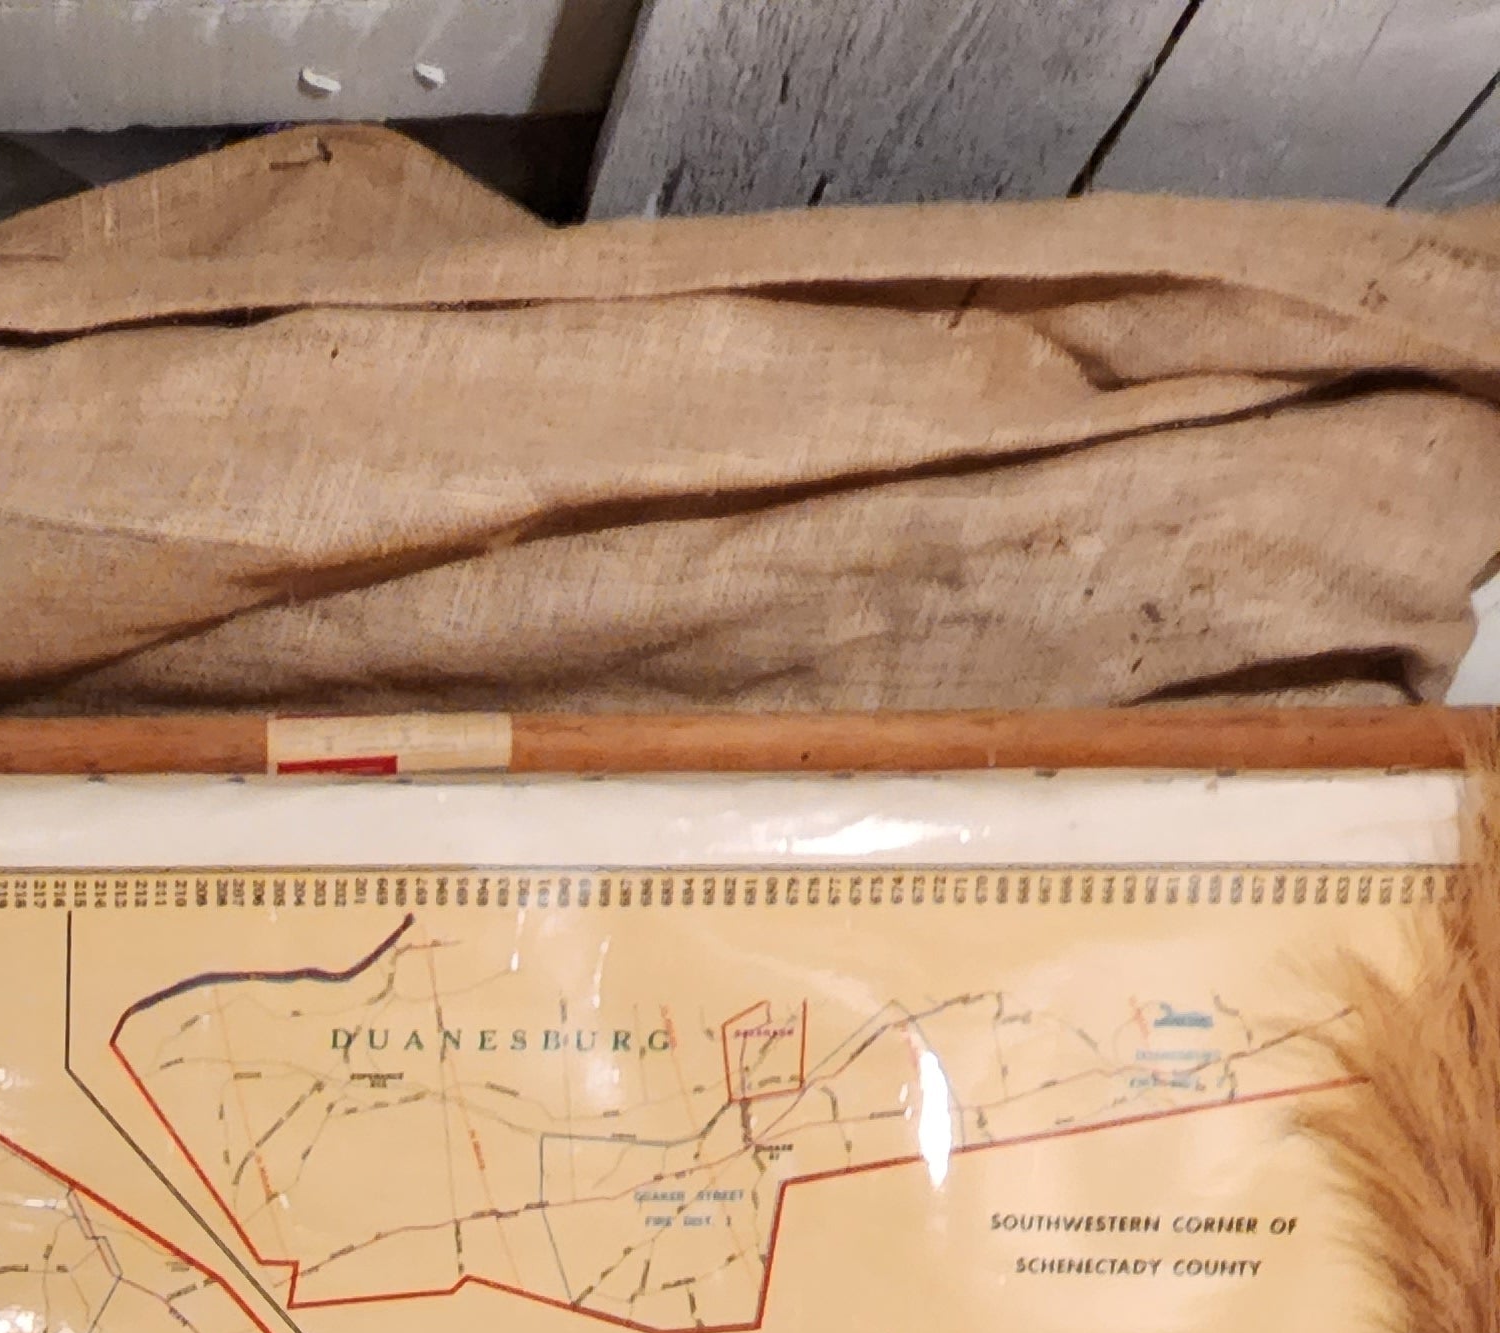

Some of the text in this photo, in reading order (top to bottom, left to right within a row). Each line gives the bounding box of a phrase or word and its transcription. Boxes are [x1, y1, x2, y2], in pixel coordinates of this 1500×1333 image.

[331, 1028, 671, 1051] DUANESBURG
[991, 1214, 1297, 1234] SOUTHWESTERN CORNER OF
[1015, 1257, 1261, 1277] SCHENECTADY COUNTY
